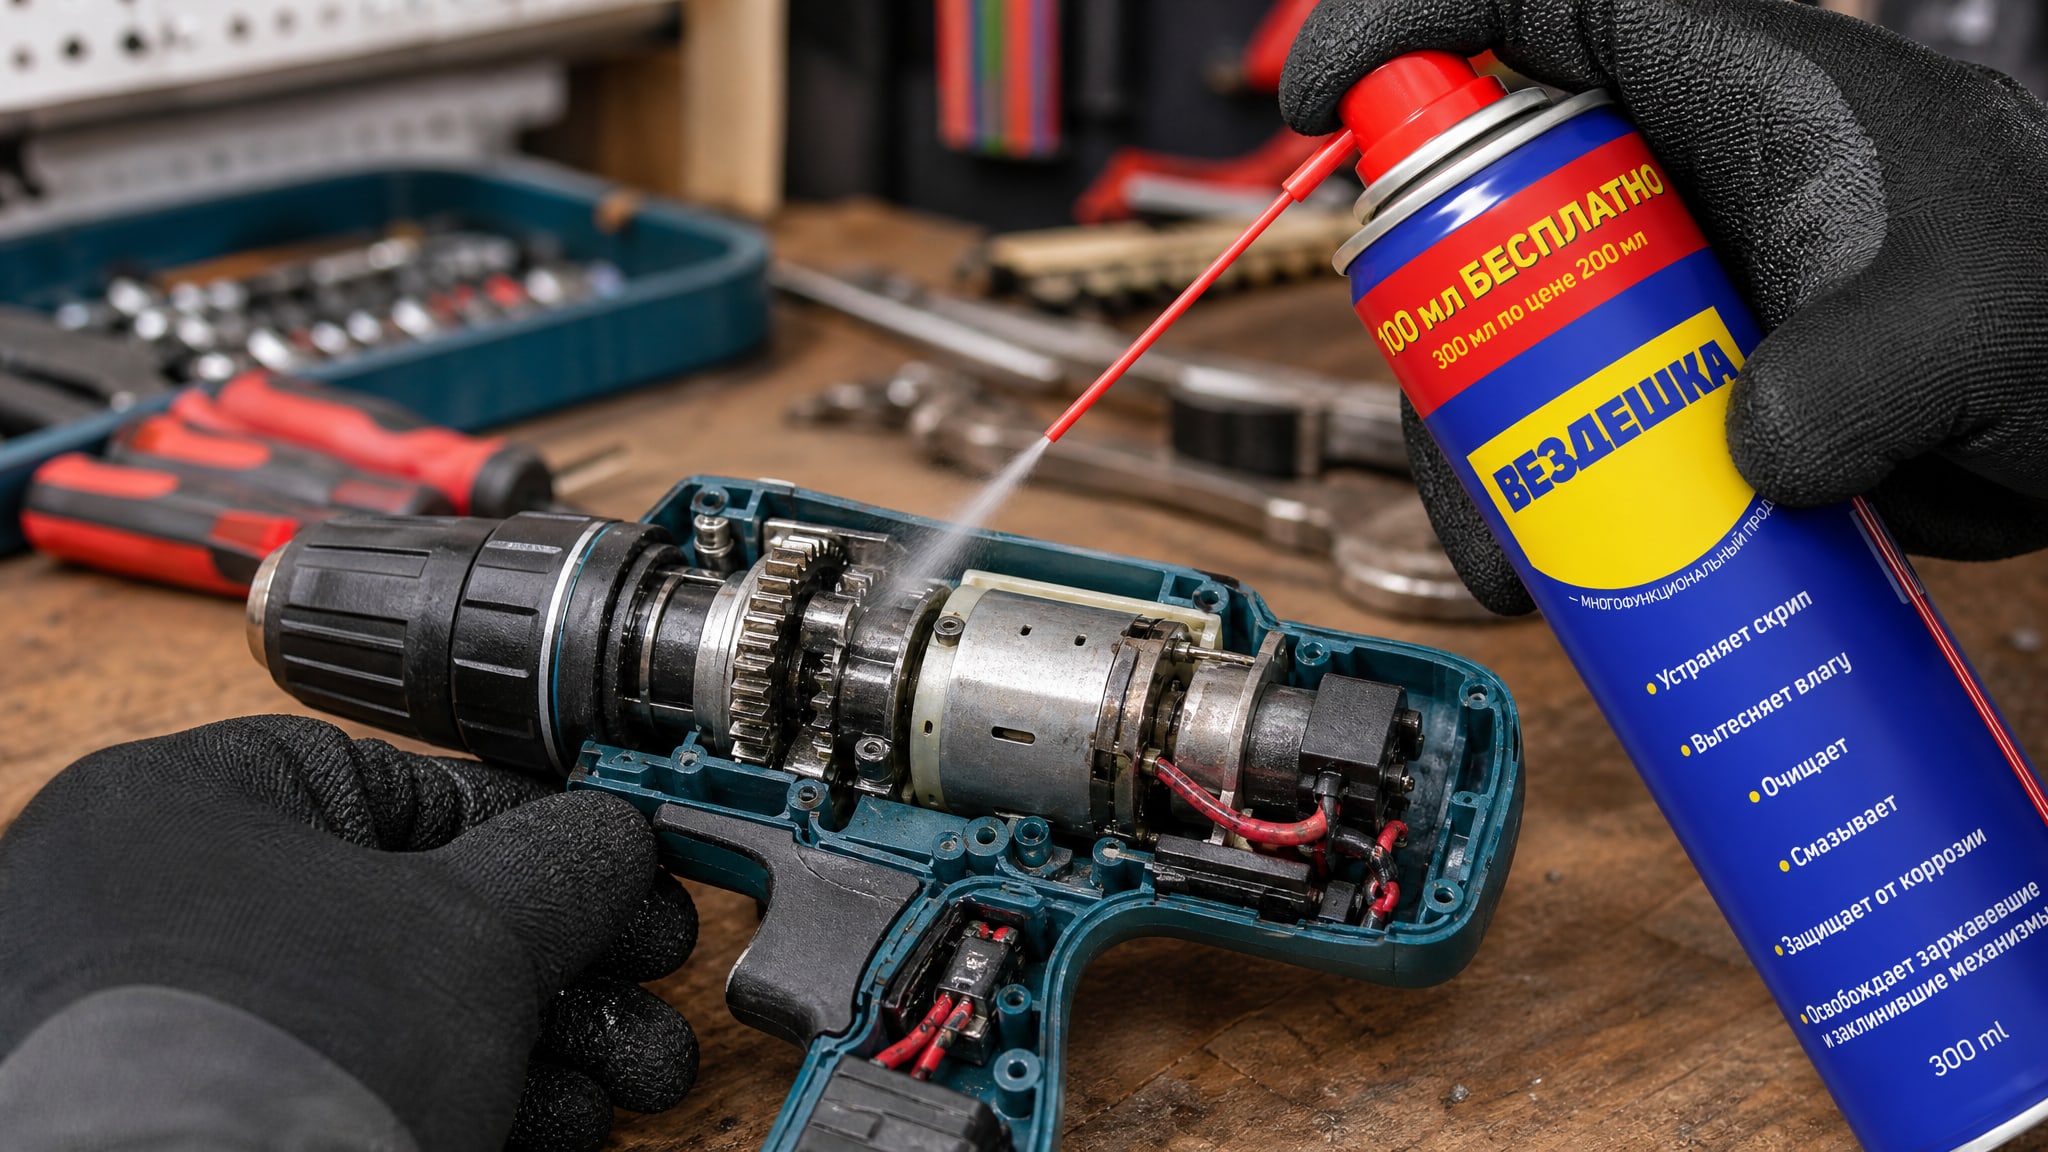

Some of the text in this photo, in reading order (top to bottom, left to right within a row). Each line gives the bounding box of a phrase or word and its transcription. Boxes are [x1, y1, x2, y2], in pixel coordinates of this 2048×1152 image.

[1377, 164, 1663, 356] 100 мл БЕСПЛАТНО
[1432, 231, 1648, 370] 300 мл по цене 200 мл
[1493, 340, 1740, 513] ВЕЗДЕШКА
[1580, 530, 1748, 611] МНОГОФУНКЦИОНАЛЬНЫЙ
[1655, 590, 1813, 691] Устраняет скрип
[1689, 651, 1852, 754] Вытесняет влагу
[1761, 737, 1849, 797] Очищает
[1790, 794, 1898, 867] Смазывает
[1781, 828, 1987, 956] Защищает от коррозии
[1805, 881, 2041, 1024] Освобождает заржавевшие
[1821, 1030, 1835, 1049] и
[1831, 973, 1949, 1045] заклинившие
[1928, 1020, 2010, 1077] 300 ml
